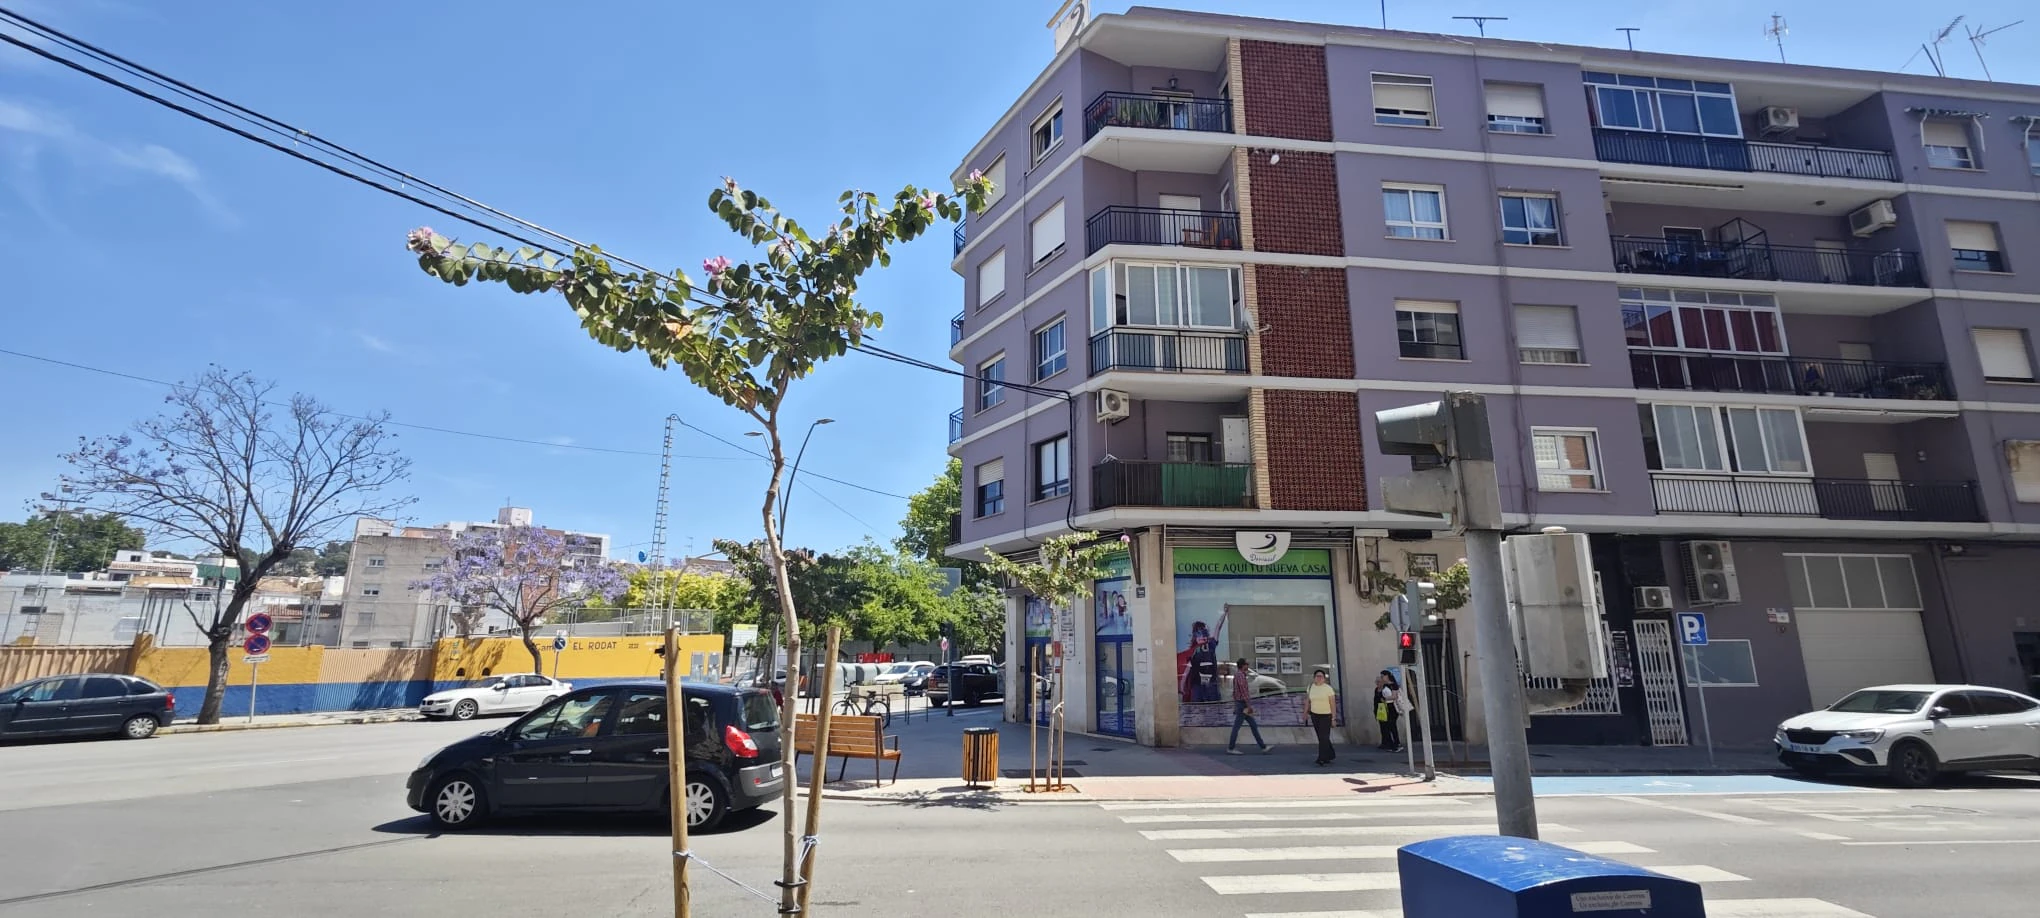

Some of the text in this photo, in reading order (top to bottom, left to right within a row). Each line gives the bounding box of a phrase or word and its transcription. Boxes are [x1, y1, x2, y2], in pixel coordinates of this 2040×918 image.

[1177, 563, 1219, 572] CONOCE
[1265, 563, 1298, 573] NUEVA
[1301, 563, 1328, 574] CASA
[1681, 615, 1700, 642] P
[573, 642, 584, 650] EL
[588, 641, 618, 650] RODAT
